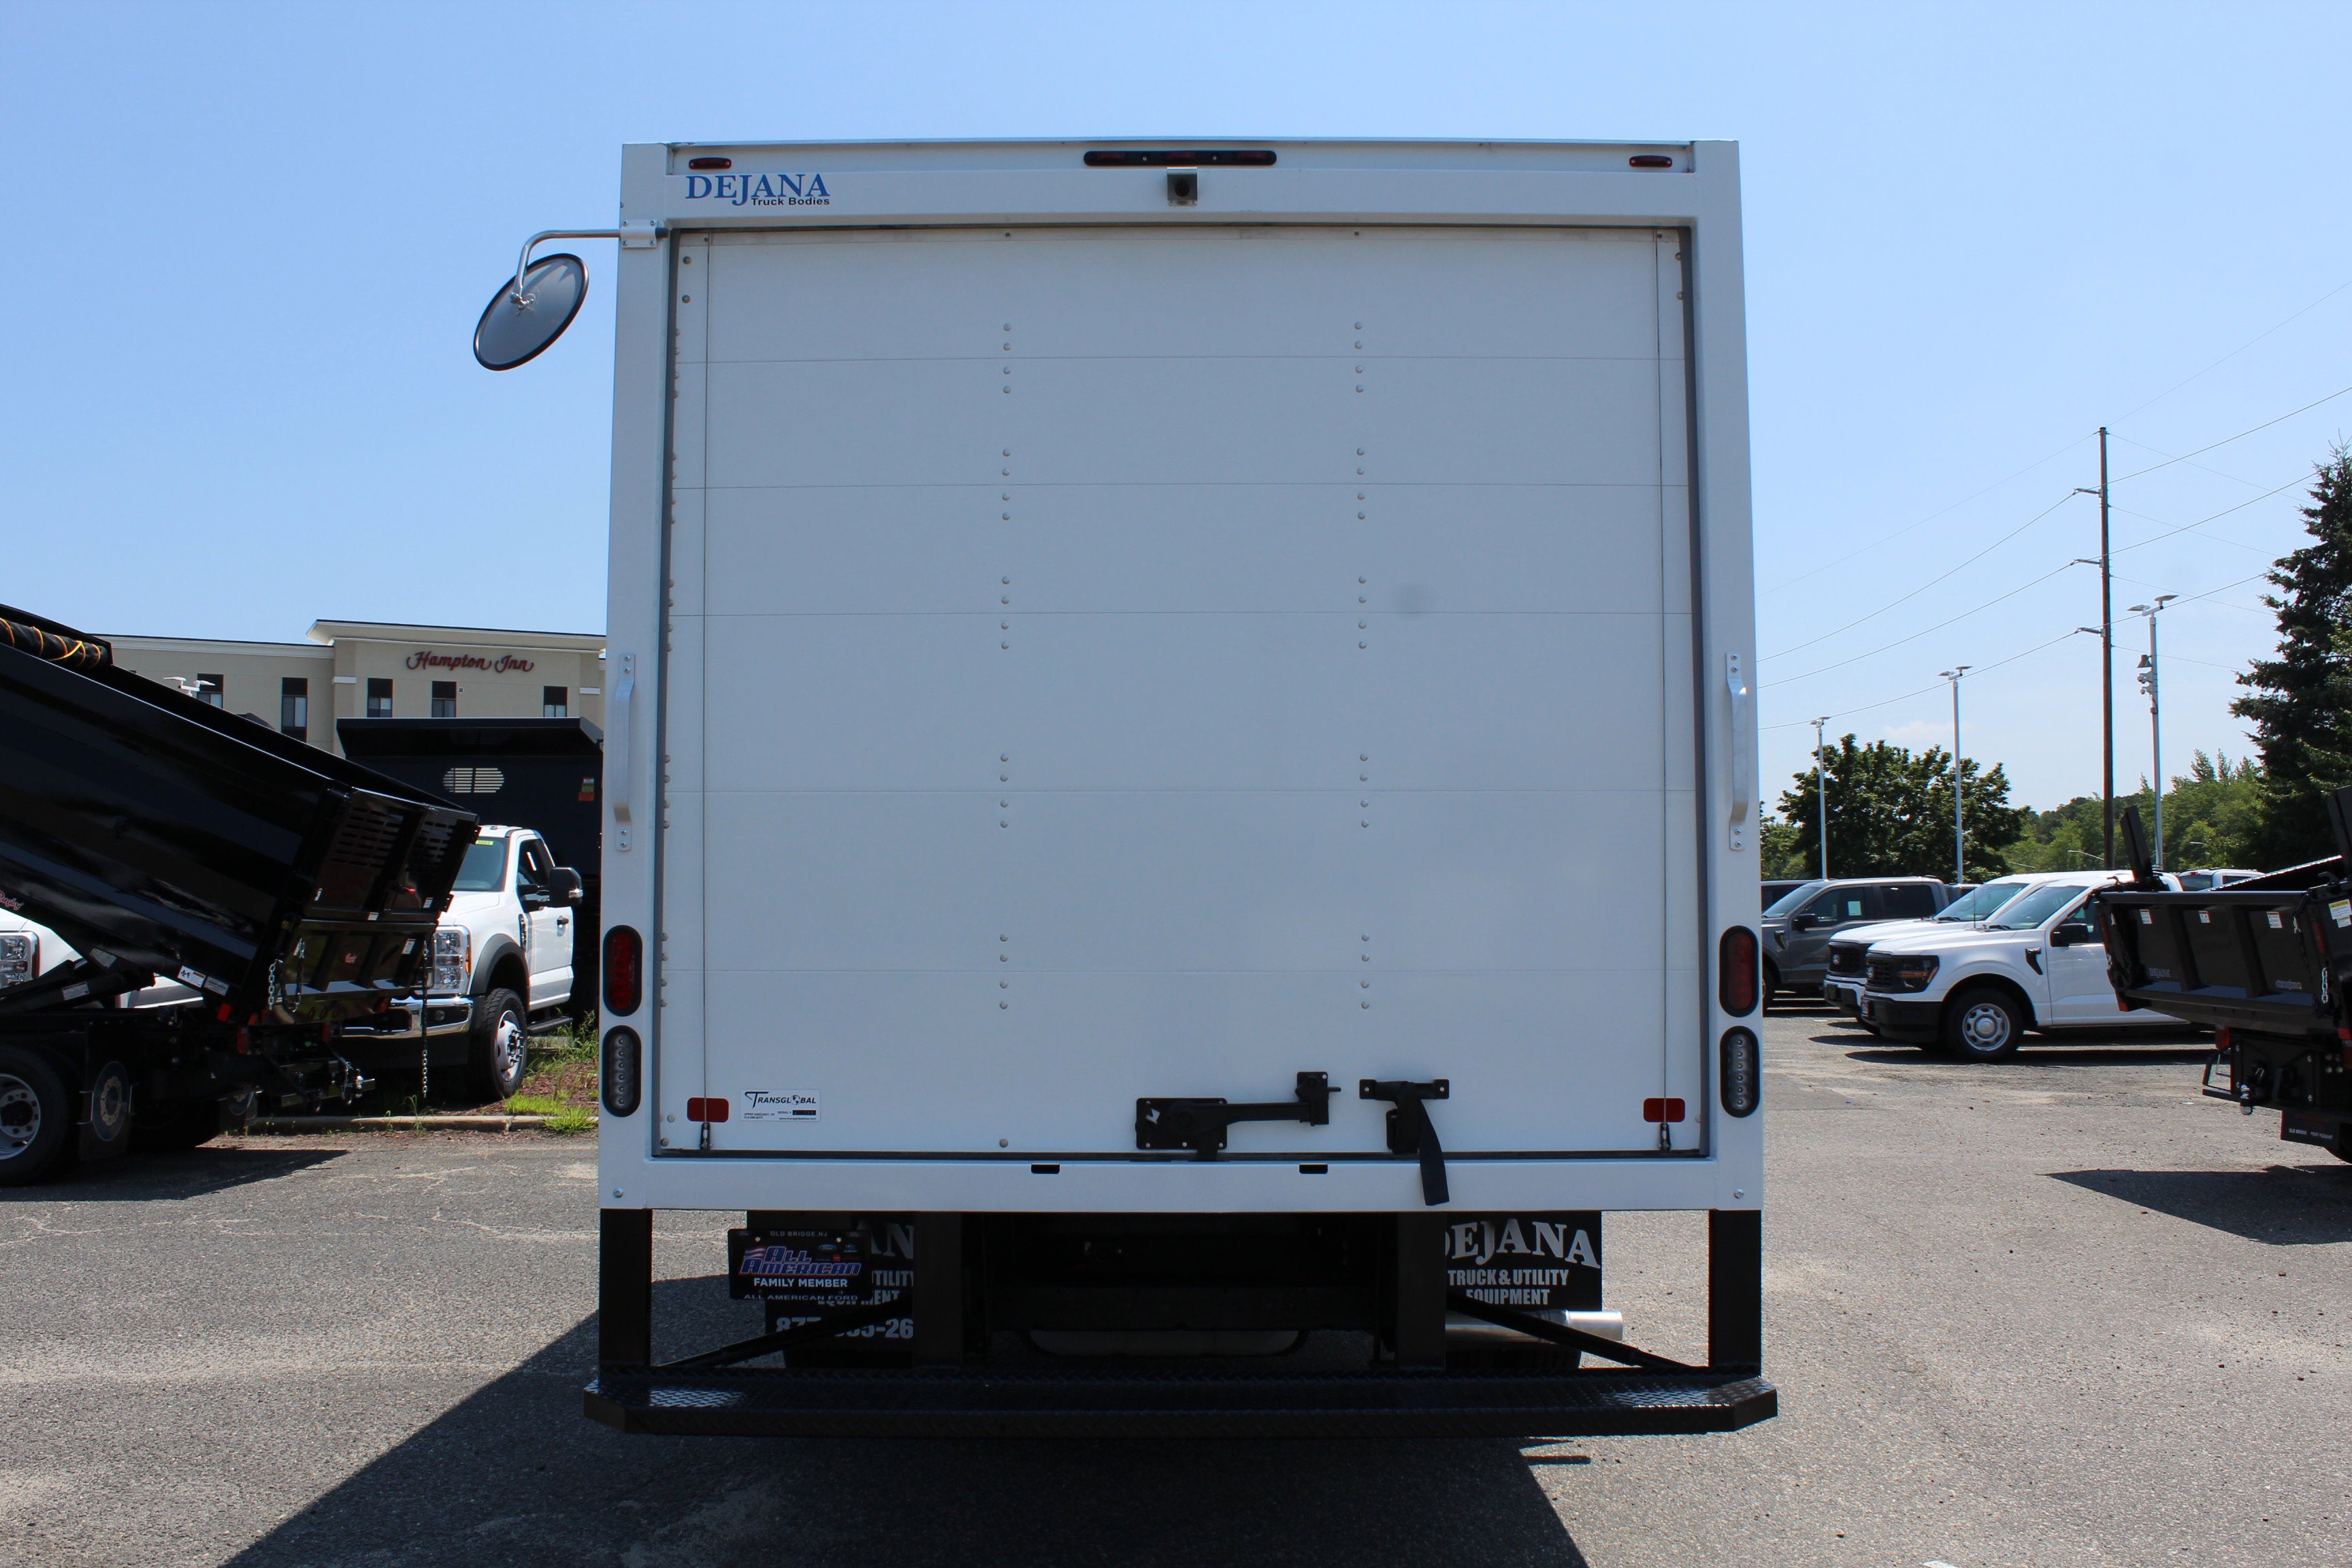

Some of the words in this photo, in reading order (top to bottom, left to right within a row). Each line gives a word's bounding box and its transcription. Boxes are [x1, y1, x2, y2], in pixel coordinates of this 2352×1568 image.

[685, 174, 831, 206] DEJANA
[751, 197, 784, 206] Truck
[788, 197, 830, 206] Bodies
[406, 651, 492, 671] Hampton
[495, 655, 535, 673] Inn
[753, 1277, 795, 1287] FAMILY
[798, 1278, 848, 1288] MEMBER
[1448, 1269, 1497, 1286] TRUCK
[1499, 1269, 1511, 1285] &
[1513, 1269, 1569, 1286] UTILITY
